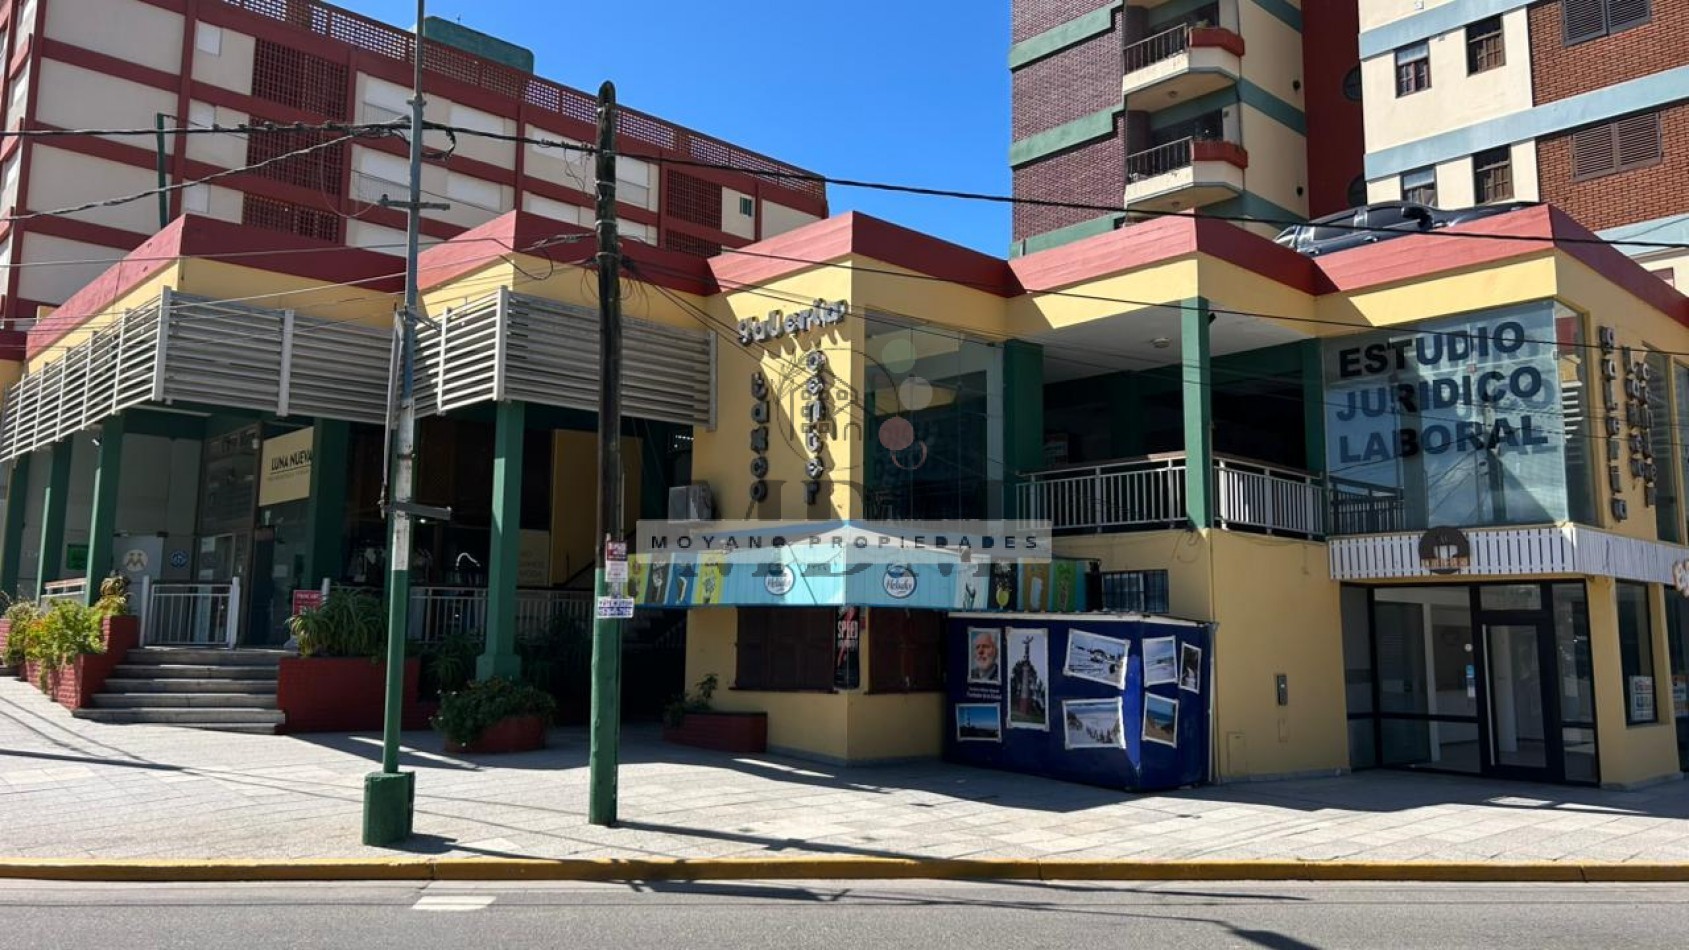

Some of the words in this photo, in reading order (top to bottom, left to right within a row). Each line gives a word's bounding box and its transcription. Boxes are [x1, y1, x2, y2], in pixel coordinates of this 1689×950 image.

[1340, 321, 1525, 378] ESTUDIO
[1336, 366, 1542, 422] JURIDICO
[272, 454, 289, 471] LUNA
[290, 448, 314, 467] NUEVA
[1340, 415, 1549, 463] LABORAL
